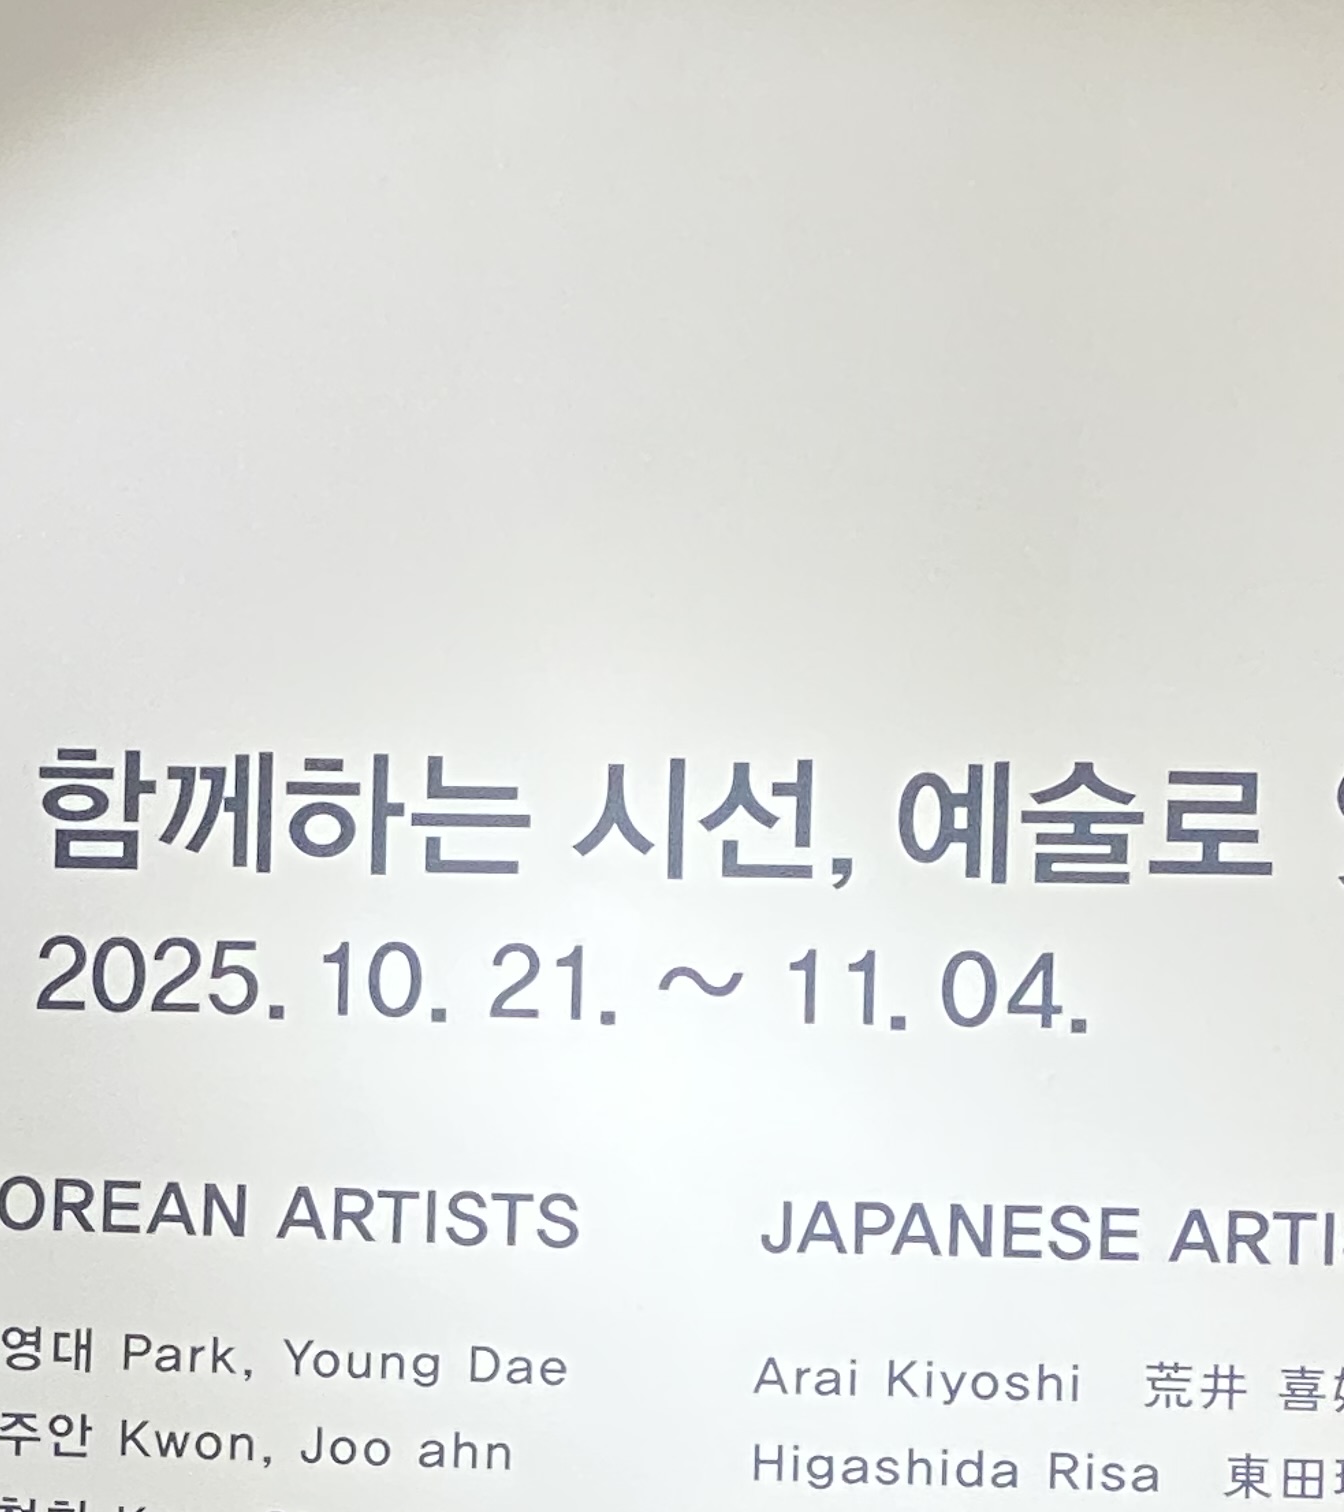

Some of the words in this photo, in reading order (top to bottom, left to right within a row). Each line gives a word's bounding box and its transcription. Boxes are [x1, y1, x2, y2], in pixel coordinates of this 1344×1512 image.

[38, 747, 531, 876] 함께하는
[572, 757, 853, 890] 시선,
[898, 760, 1273, 885] 예술로
[36, 934, 285, 1020] 2025.
[322, 941, 447, 1023] 10.
[489, 942, 616, 1026] 21.
[789, 948, 907, 1031] 11.
[941, 950, 1087, 1034] 04.
[275, 1185, 580, 1249] ARTISTS
[760, 1200, 1140, 1262] JAPANESE
[1168, 1208, 1344, 1267] ARTI
[122, 1333, 253, 1382] Park,
[283, 1338, 440, 1388] Young
[470, 1345, 567, 1386] Dae
[753, 1356, 857, 1397] Arai
[887, 1359, 1079, 1406] Kiyoshi
[1143, 1361, 1248, 1411] 荒井
[1278, 1365, 1344, 1413] 喜
[120, 1419, 272, 1469] Kwon,
[300, 1426, 391, 1467] Joo
[418, 1430, 511, 1471] ahn
[753, 1443, 1018, 1490] Higashida
[1049, 1451, 1159, 1493] Risa
[1223, 1452, 1344, 1500] 東田
